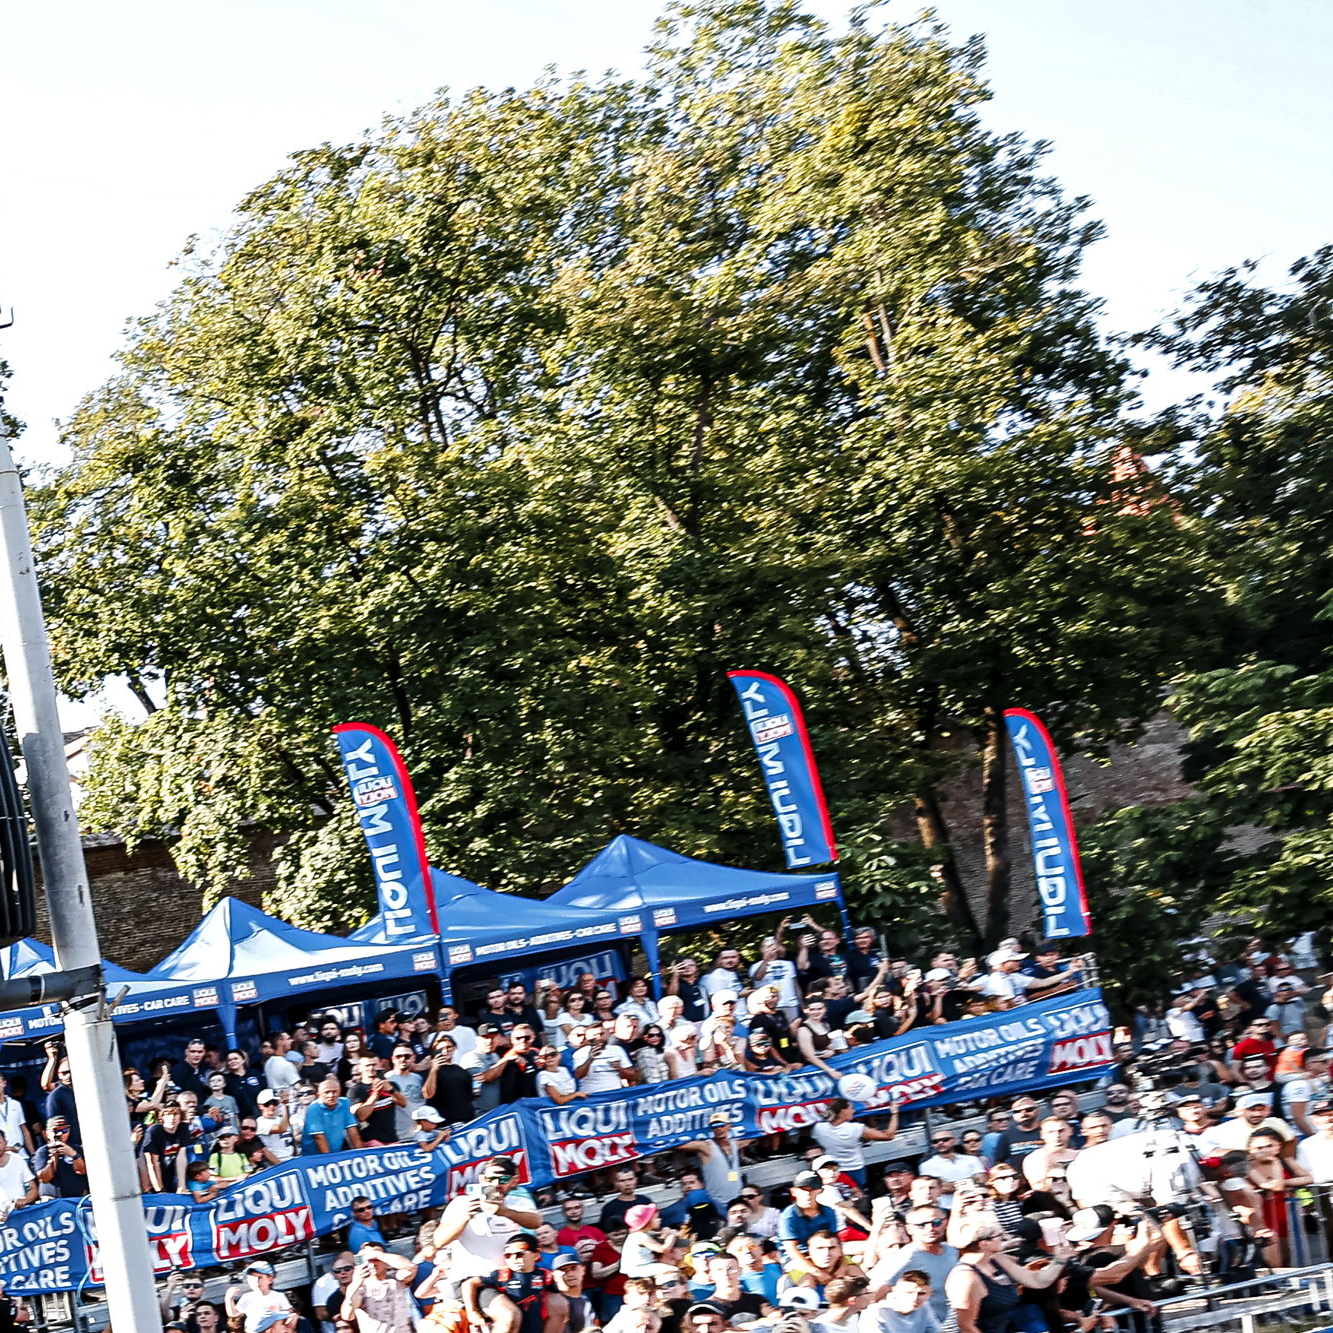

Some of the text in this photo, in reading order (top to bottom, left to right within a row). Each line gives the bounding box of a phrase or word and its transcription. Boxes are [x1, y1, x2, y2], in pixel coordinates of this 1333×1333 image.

[935, 1017, 1046, 1060] MOTOR OILS
[636, 1079, 748, 1117] MOTOR OILS
[446, 1119, 519, 1165] LIQUI
[543, 1102, 629, 1140] LIQUI
[306, 1148, 434, 1190] MOTOR OILS
[552, 1134, 635, 1173] MOLY
[218, 1174, 302, 1223] LIQUI
[325, 1167, 436, 1212] ADDITIVES
[22, 1212, 75, 1243] OILS
[219, 1207, 310, 1259] MOLY
